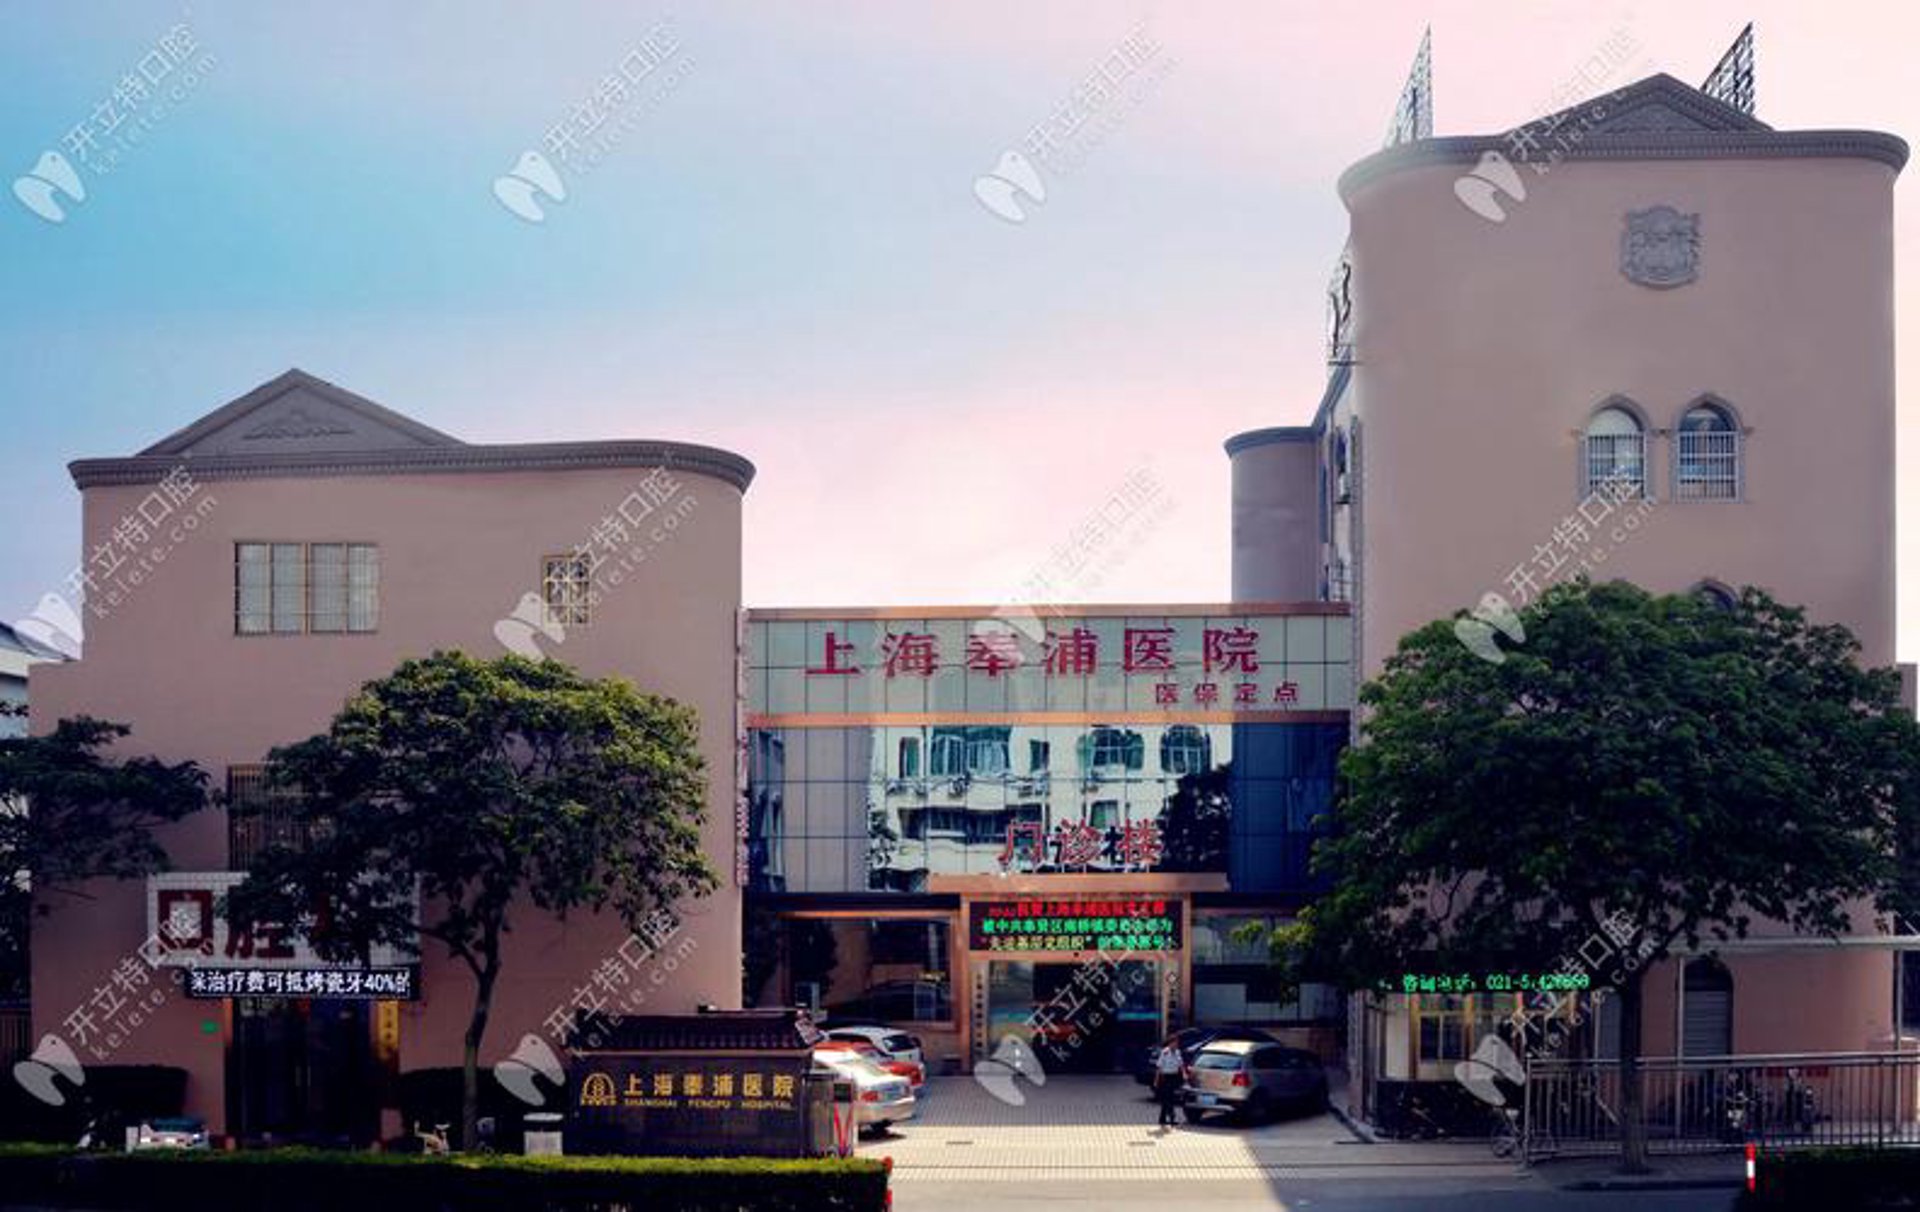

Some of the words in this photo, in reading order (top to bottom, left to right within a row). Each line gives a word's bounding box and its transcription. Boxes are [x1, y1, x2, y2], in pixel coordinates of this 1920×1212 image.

[805, 627, 1260, 678] 上海奉浦医院
[1155, 682, 1299, 705] 医保定点
[998, 818, 1163, 865] 门诊楼
[623, 1073, 794, 1098] 上海奉浦医院
